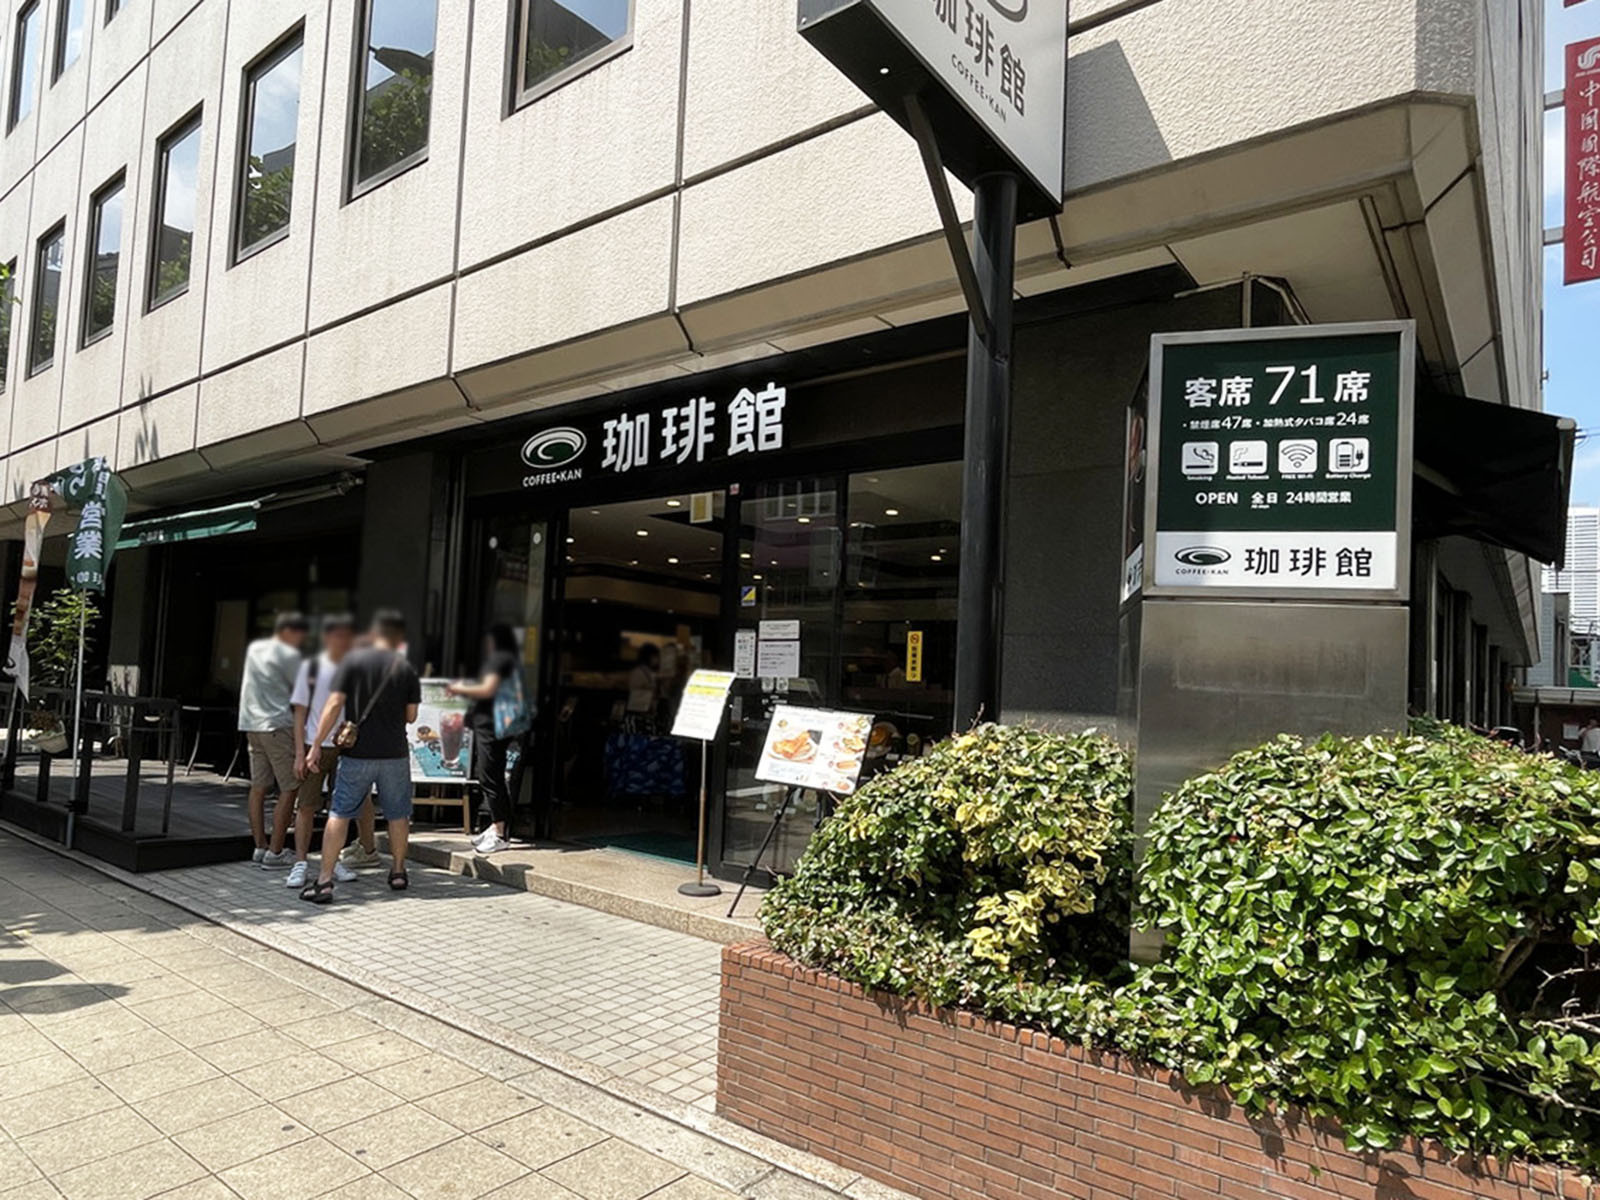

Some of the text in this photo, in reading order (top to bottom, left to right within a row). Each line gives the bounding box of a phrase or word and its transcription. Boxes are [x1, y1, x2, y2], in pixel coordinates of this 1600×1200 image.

[601, 382, 787, 472] 珈琲館
[1195, 491, 1239, 505] OPEN
[1251, 491, 1278, 505] 全日
[1244, 547, 1373, 578] 珈琲館
